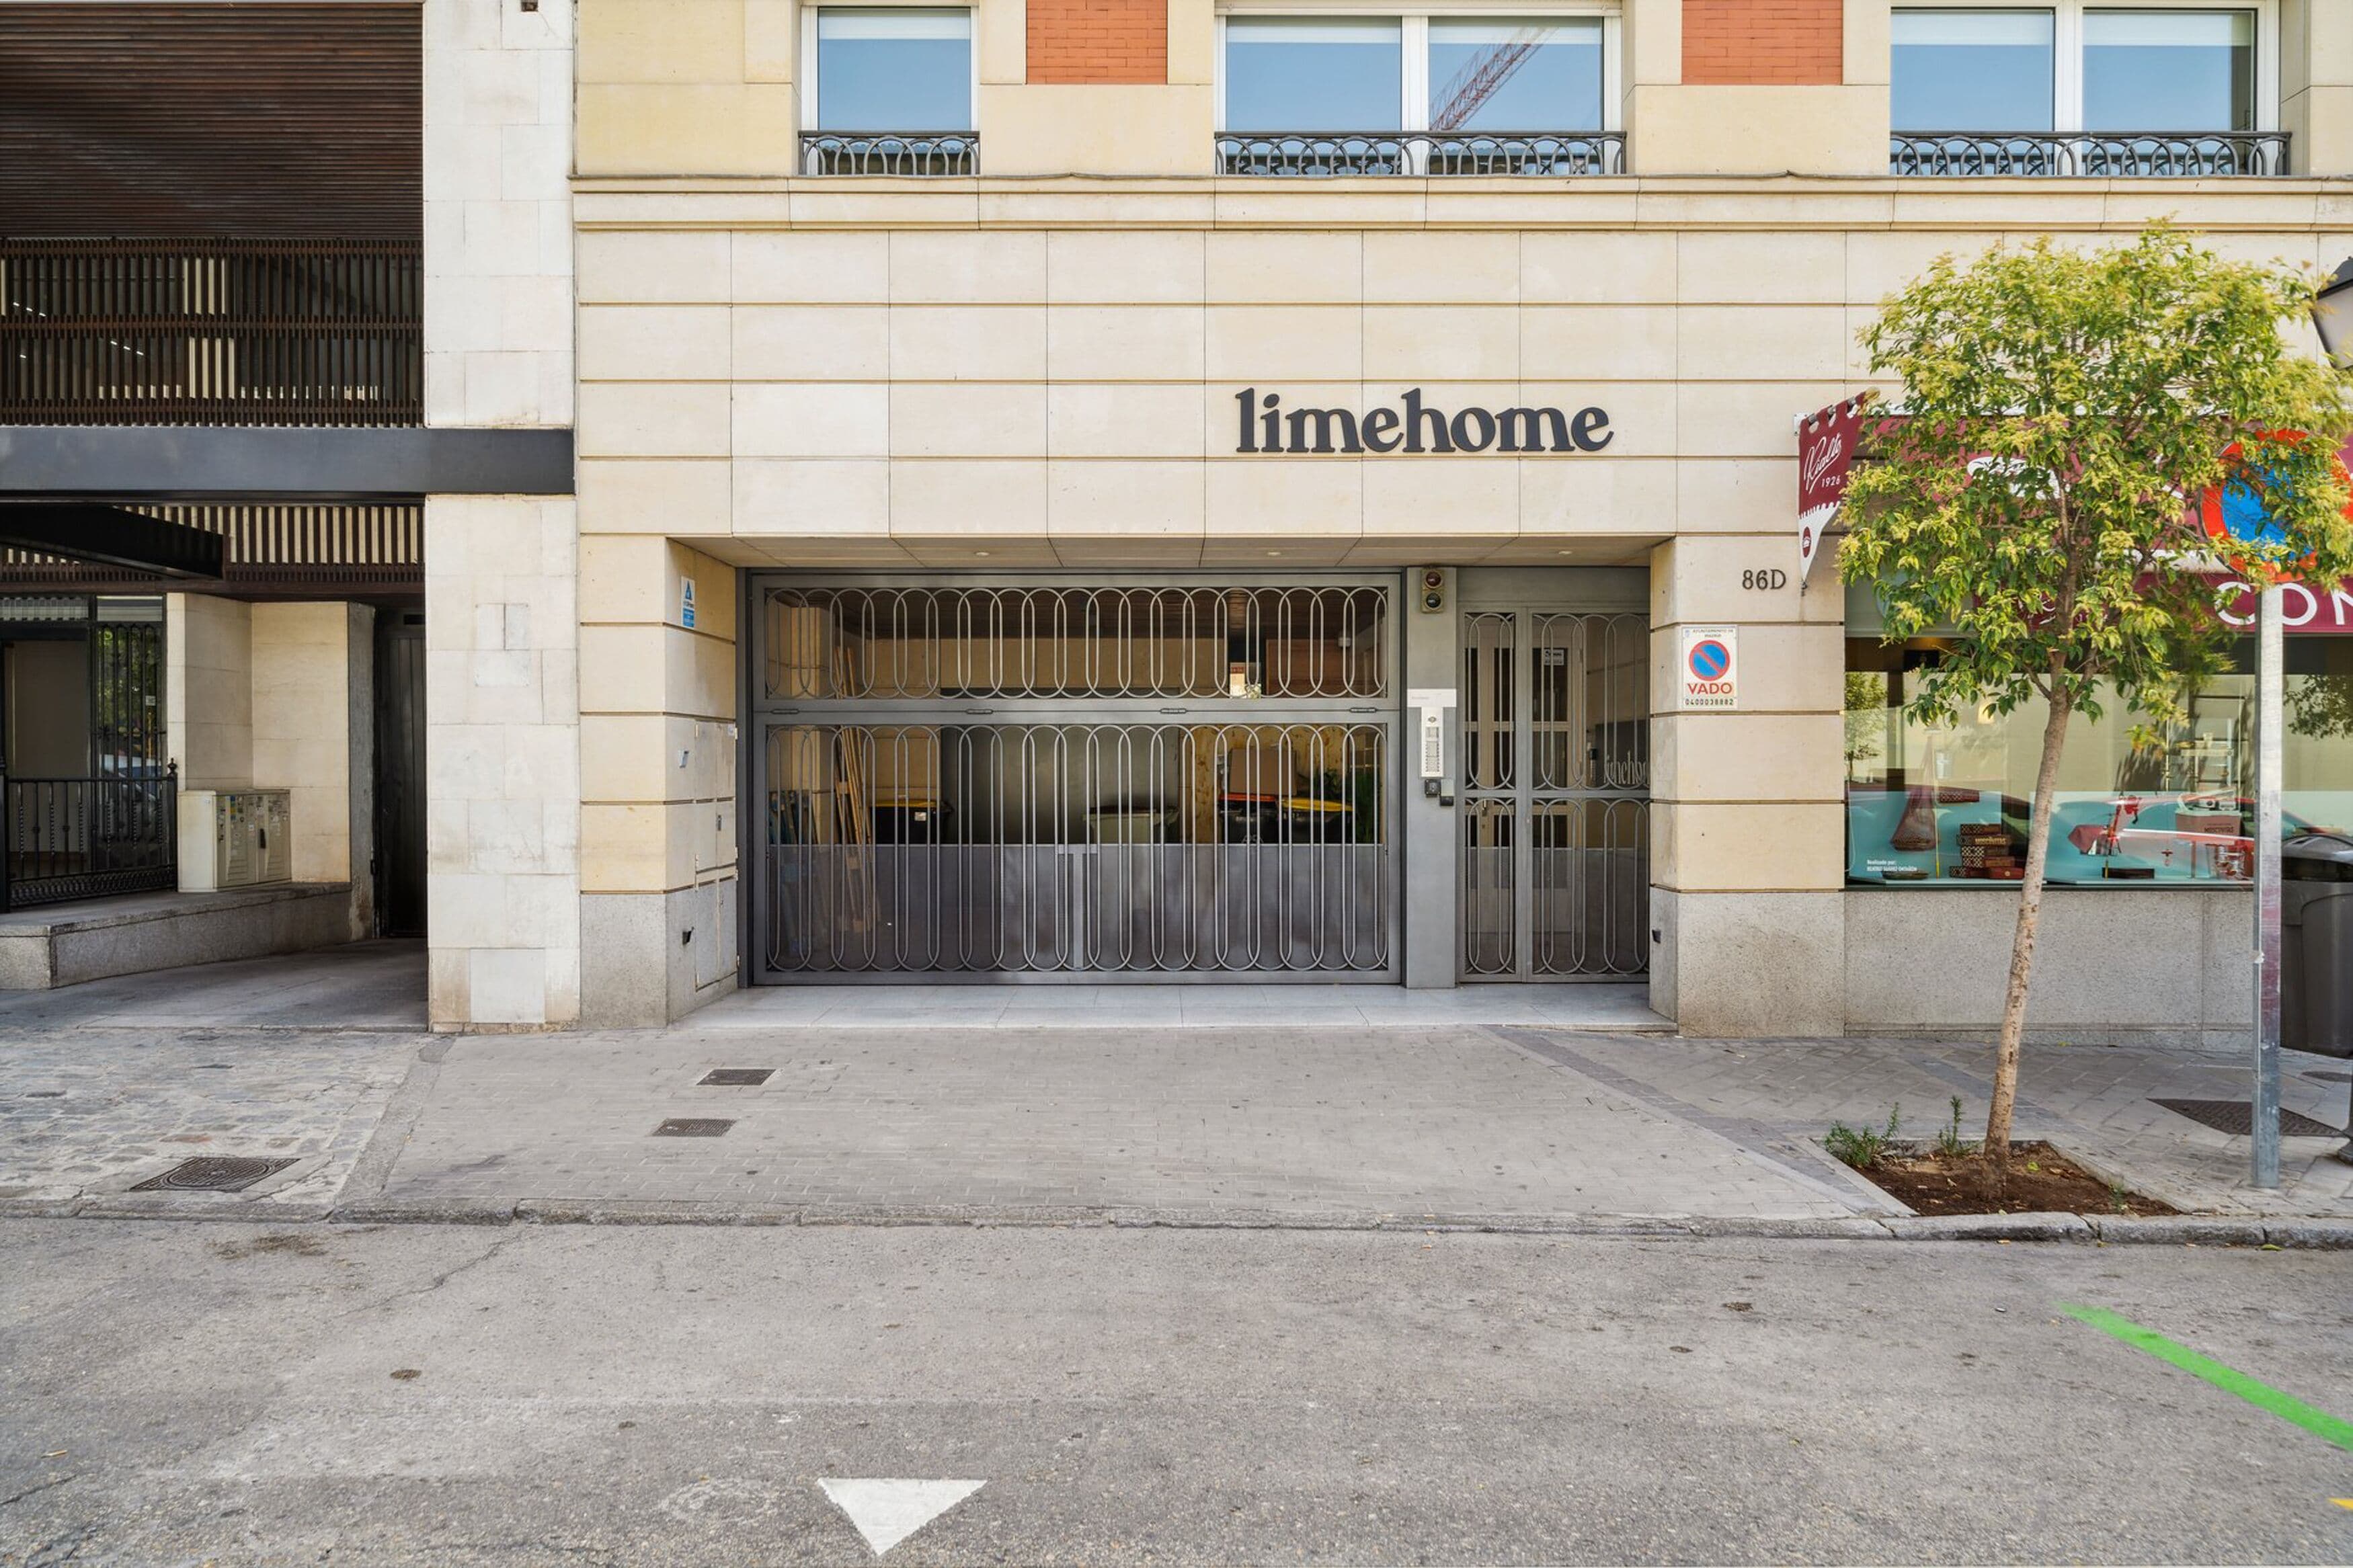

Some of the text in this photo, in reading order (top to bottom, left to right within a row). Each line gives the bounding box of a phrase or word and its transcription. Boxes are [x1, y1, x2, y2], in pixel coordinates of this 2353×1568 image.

[1235, 387, 1614, 453] limehome
[1822, 475, 1841, 488] 1926
[1742, 569, 1786, 590] 86D
[1687, 682, 1732, 695] VADO
